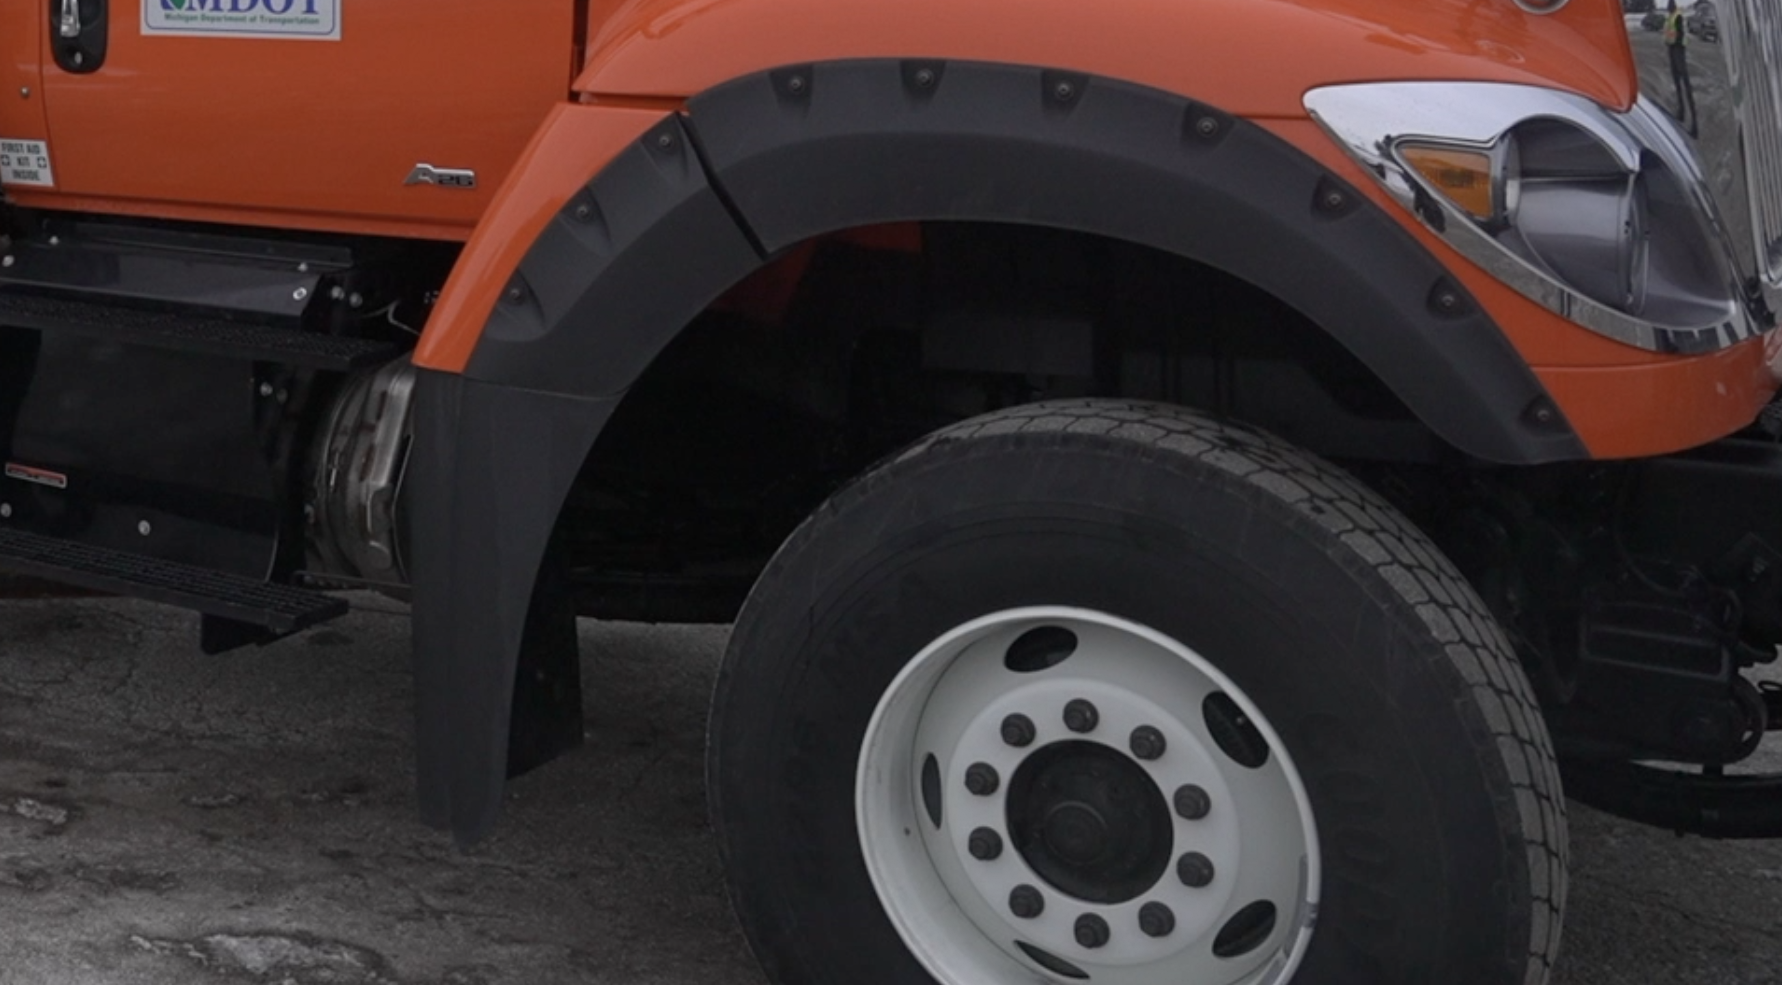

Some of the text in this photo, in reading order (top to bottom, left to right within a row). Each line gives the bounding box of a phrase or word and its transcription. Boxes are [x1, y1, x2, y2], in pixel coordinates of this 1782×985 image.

[164, 12, 320, 26] Michigan Department of Transportation
[1, 142, 41, 155] FIRST AID
[17, 156, 31, 167] KIT
[12, 168, 42, 182] INSIDE
